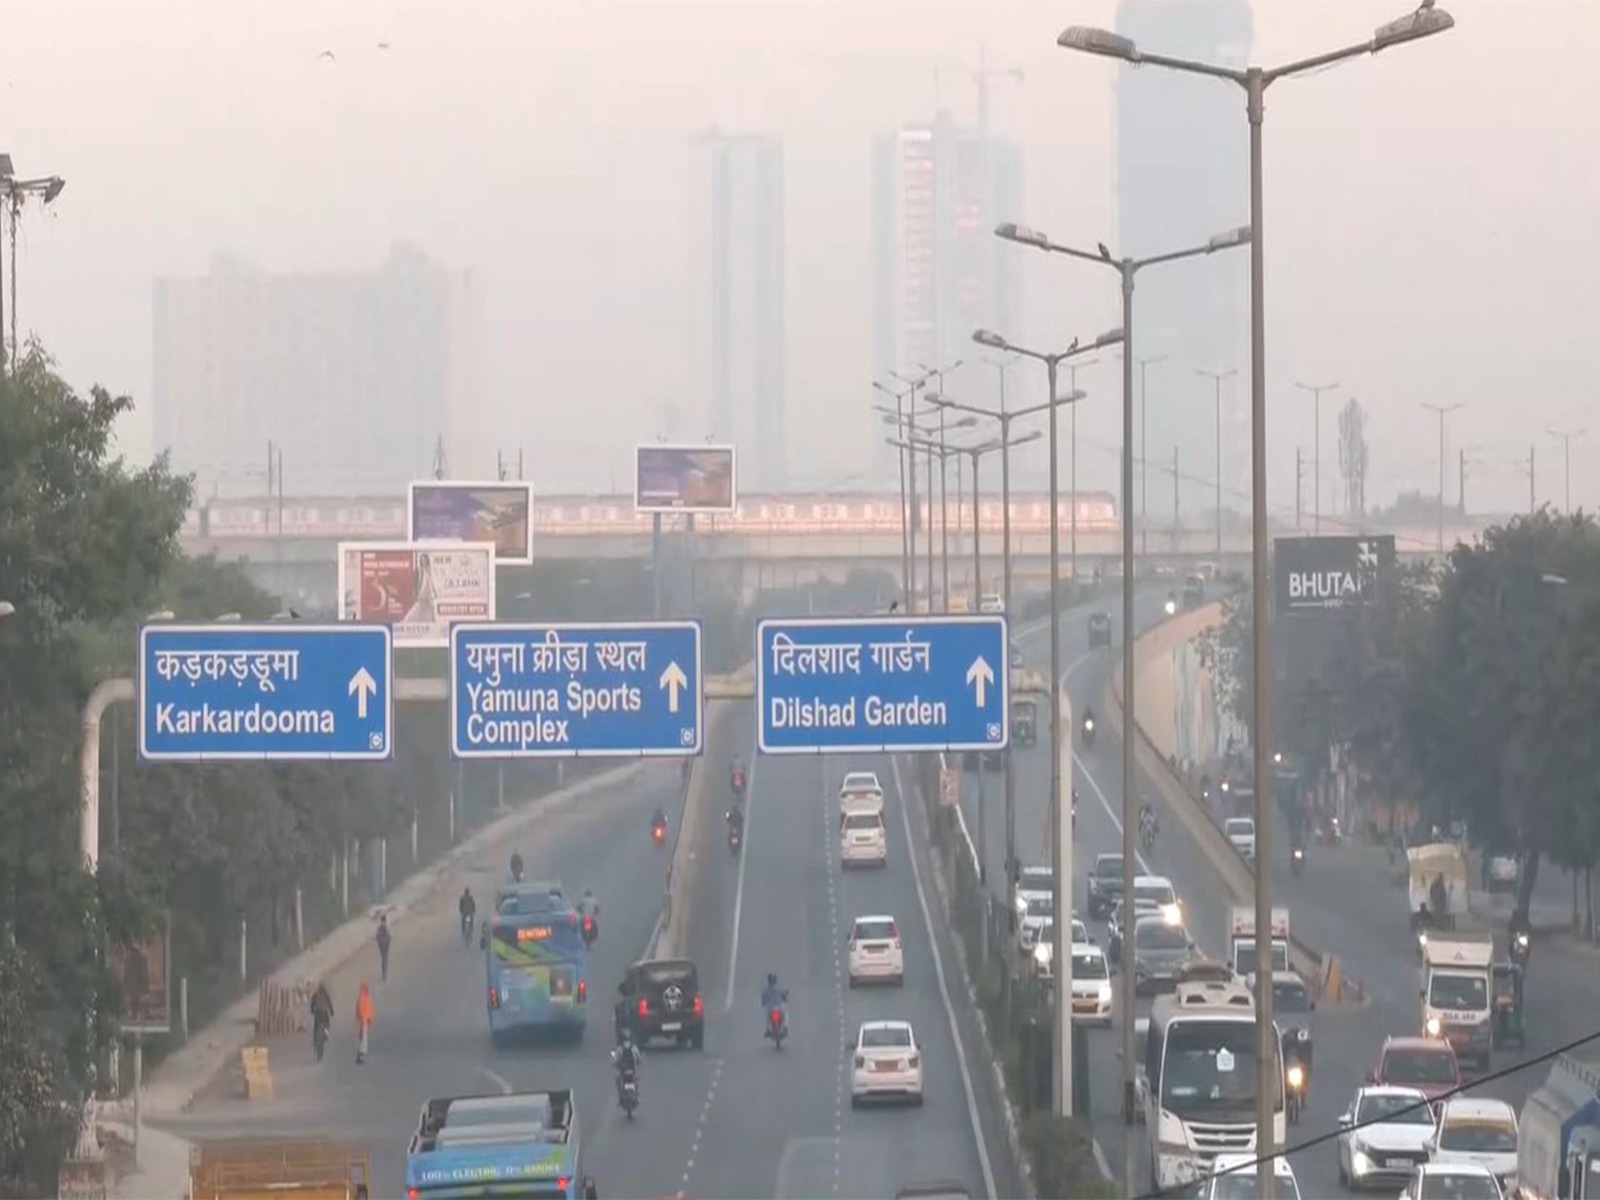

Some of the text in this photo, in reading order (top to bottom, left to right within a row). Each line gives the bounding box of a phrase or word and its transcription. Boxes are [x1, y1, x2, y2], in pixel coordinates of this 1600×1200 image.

[466, 631, 647, 687] यमुना क्रीड़ा स्थल
[771, 630, 931, 675] दिलशाद गार्डन
[155, 649, 299, 692] कड़कड़डूमा
[467, 683, 641, 718] Yamuna Sports
[772, 695, 946, 727] Dilshad Garden
[156, 703, 334, 734] Karkardooma
[467, 714, 569, 748] Complex
